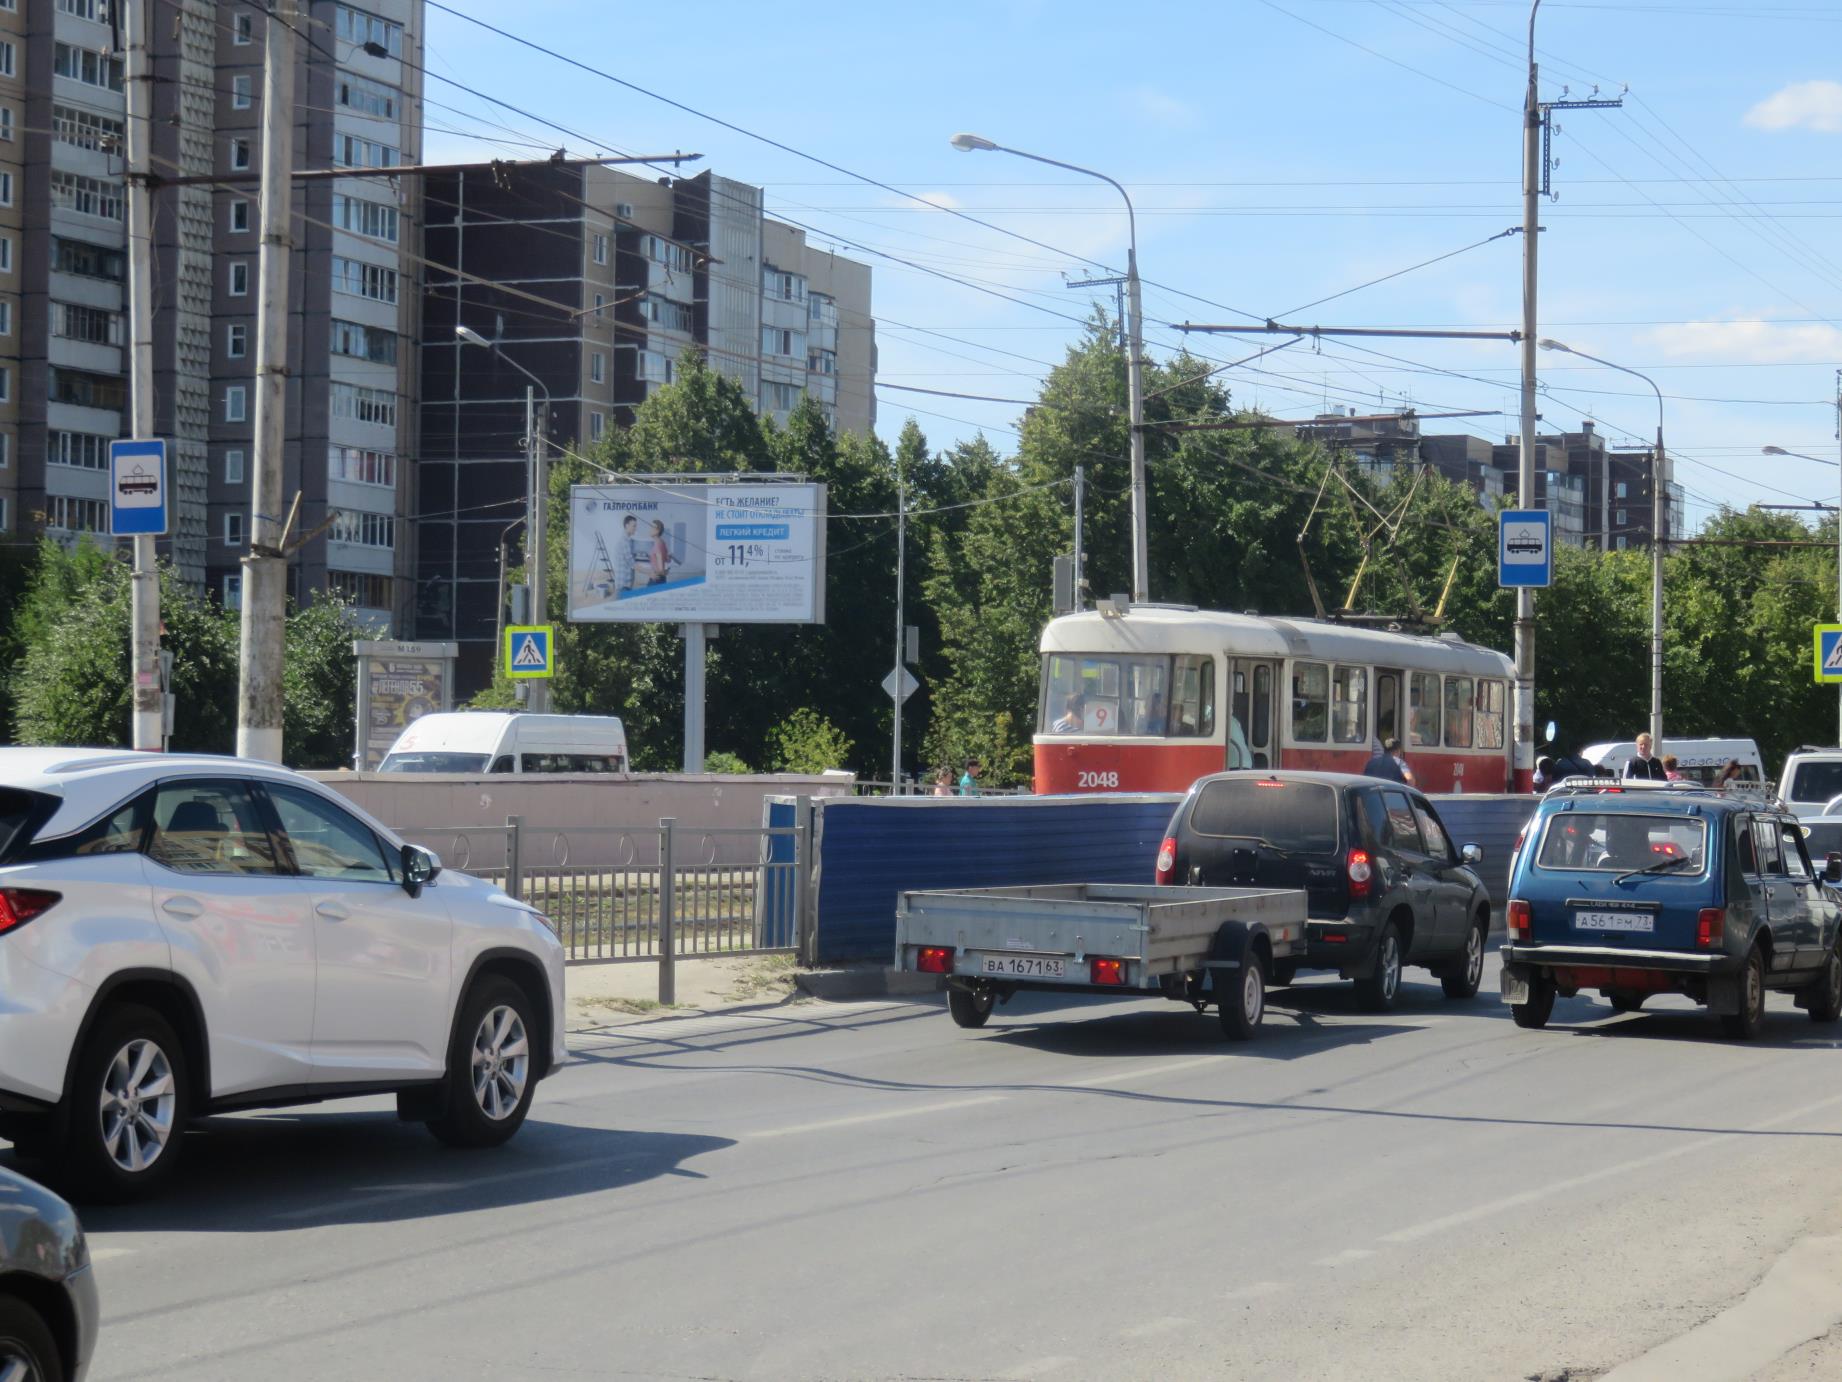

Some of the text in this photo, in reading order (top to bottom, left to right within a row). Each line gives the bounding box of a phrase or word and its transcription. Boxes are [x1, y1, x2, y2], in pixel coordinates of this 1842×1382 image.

[603, 501, 658, 511] ГАЗПРОМБАНК
[736, 496, 780, 507] ЖЕЛАНИЕ?
[753, 527, 785, 537] КРЕДИТ
[1096, 708, 1107, 726] 9
[1078, 771, 1119, 788] 2048
